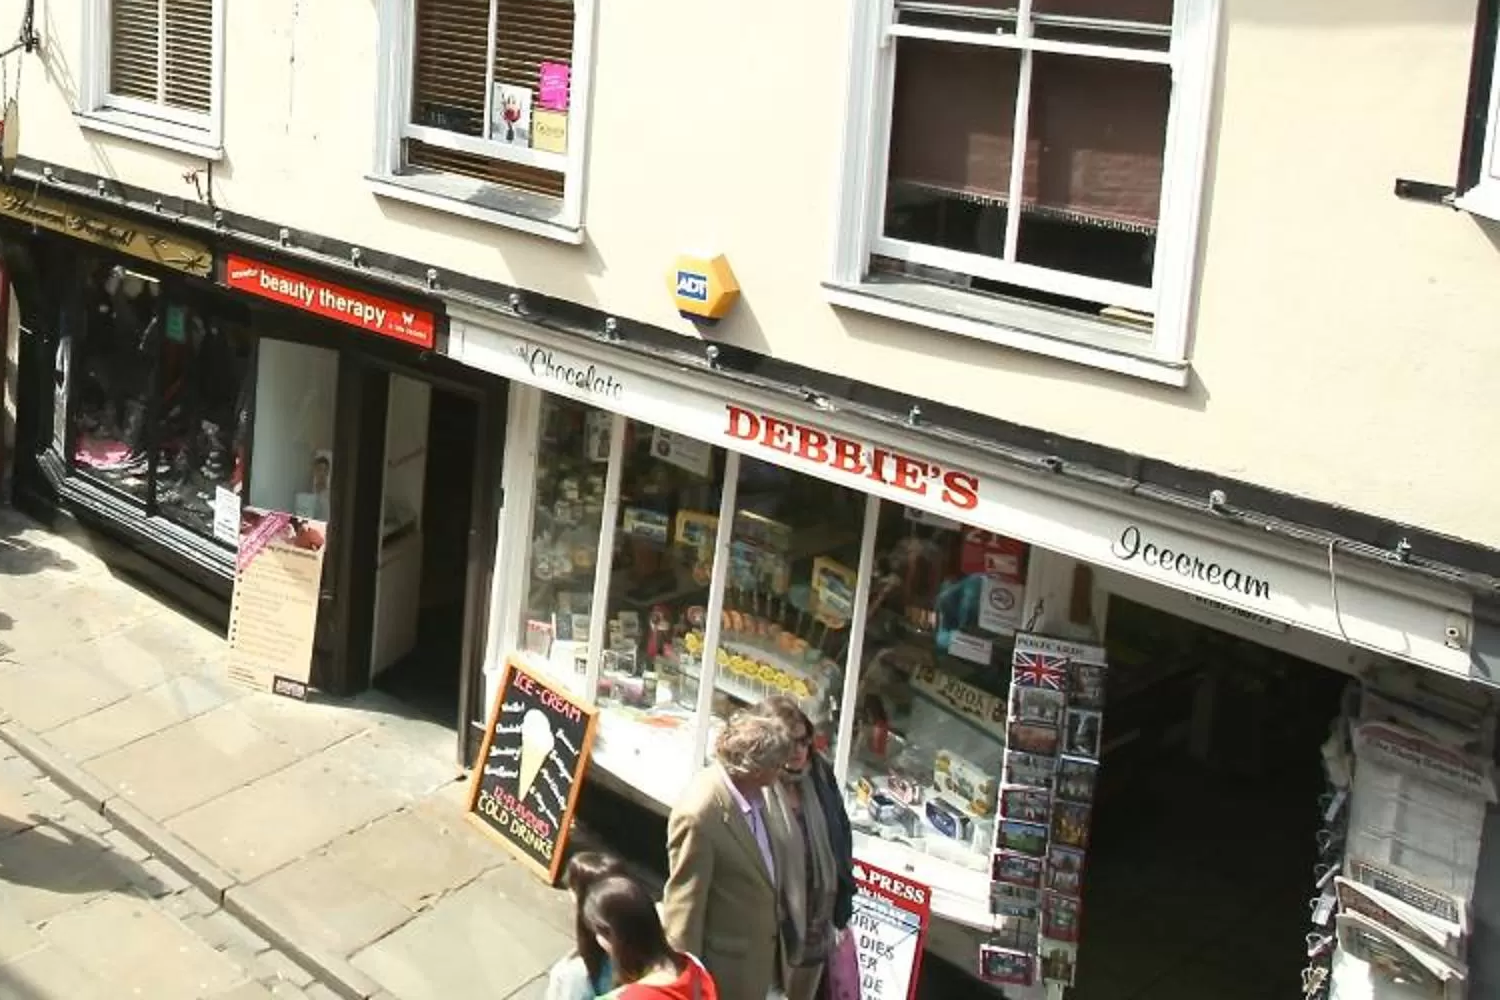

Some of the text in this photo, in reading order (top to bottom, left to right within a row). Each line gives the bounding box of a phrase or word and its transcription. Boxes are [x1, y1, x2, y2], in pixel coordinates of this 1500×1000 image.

[259, 269, 315, 307] beauty
[318, 288, 387, 329] therapy
[530, 349, 622, 399] Chocolate
[724, 403, 980, 510] DEBBIE'S
[1111, 524, 1271, 599] Icecream
[477, 792, 509, 825] COLD
[510, 816, 553, 859] DRINKS
[869, 870, 925, 904] PRESS
